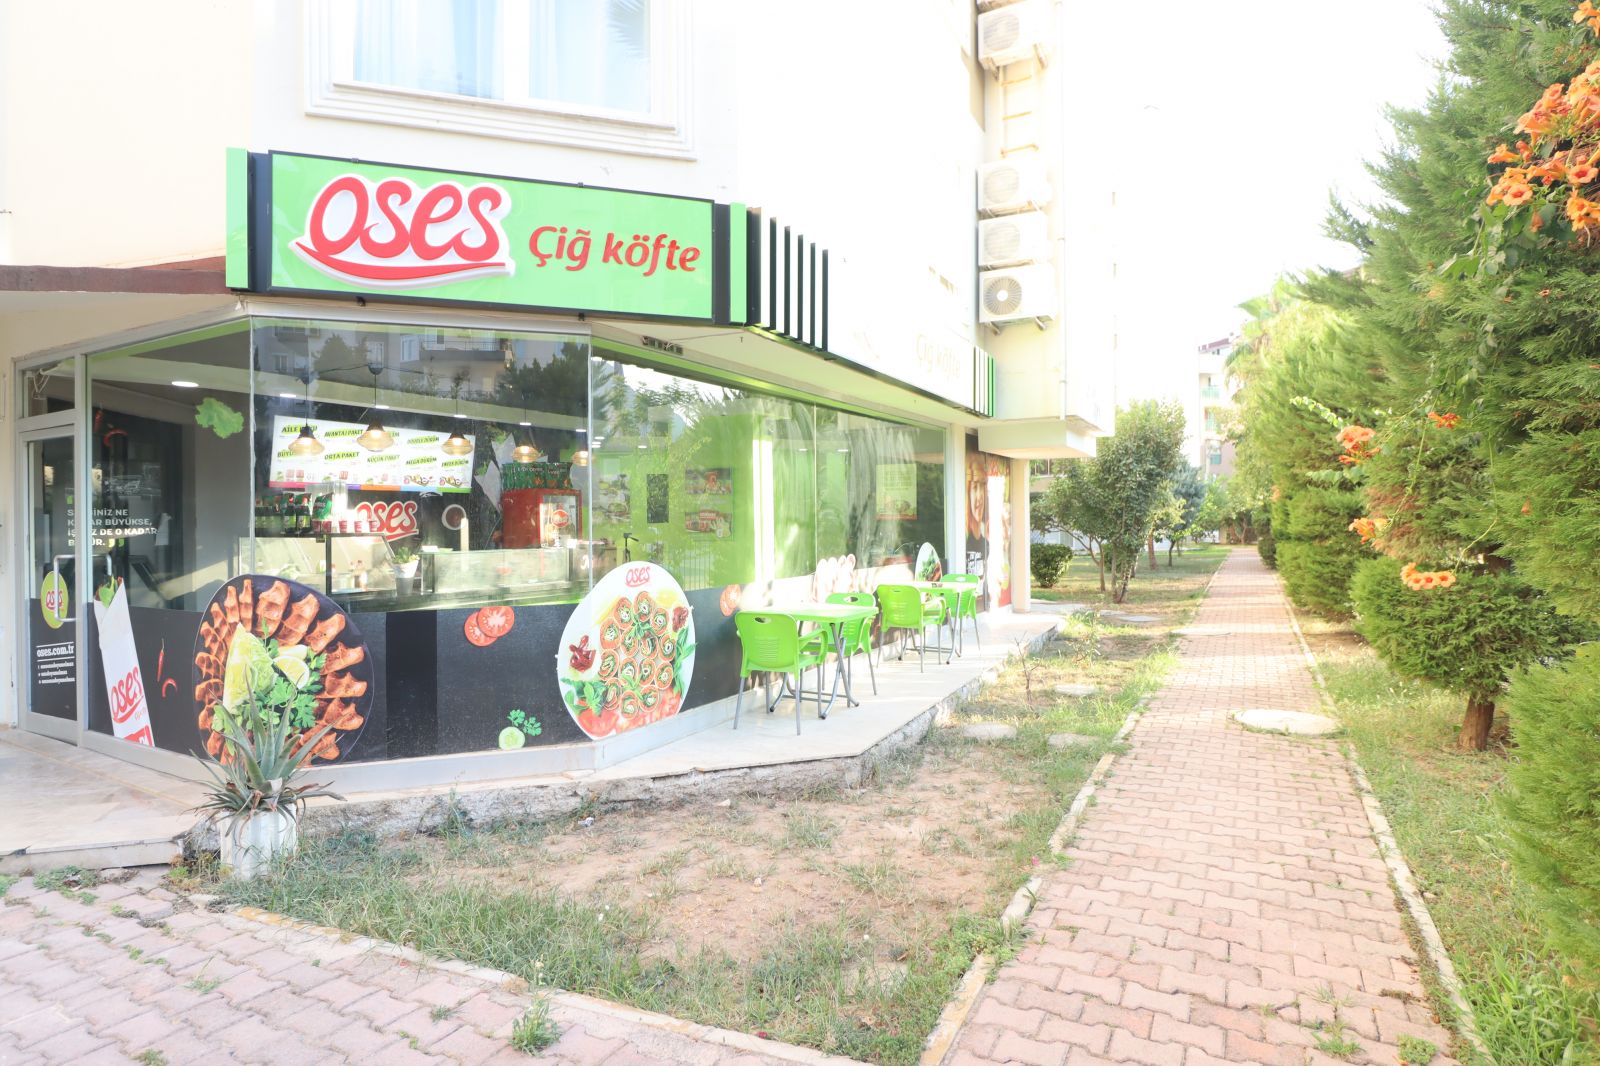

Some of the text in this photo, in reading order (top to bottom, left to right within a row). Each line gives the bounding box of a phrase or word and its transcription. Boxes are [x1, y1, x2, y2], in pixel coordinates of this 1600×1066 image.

[528, 225, 702, 279] Çiğ köfte
[347, 428, 364, 436] PAKET
[324, 451, 360, 461] ORTA PAKET
[105, 517, 153, 526] BÜYÜKSE,
[100, 528, 113, 536] DE
[115, 528, 122, 536] O
[124, 527, 158, 536] KADAR
[36, 644, 75, 658] oses.com.tr
